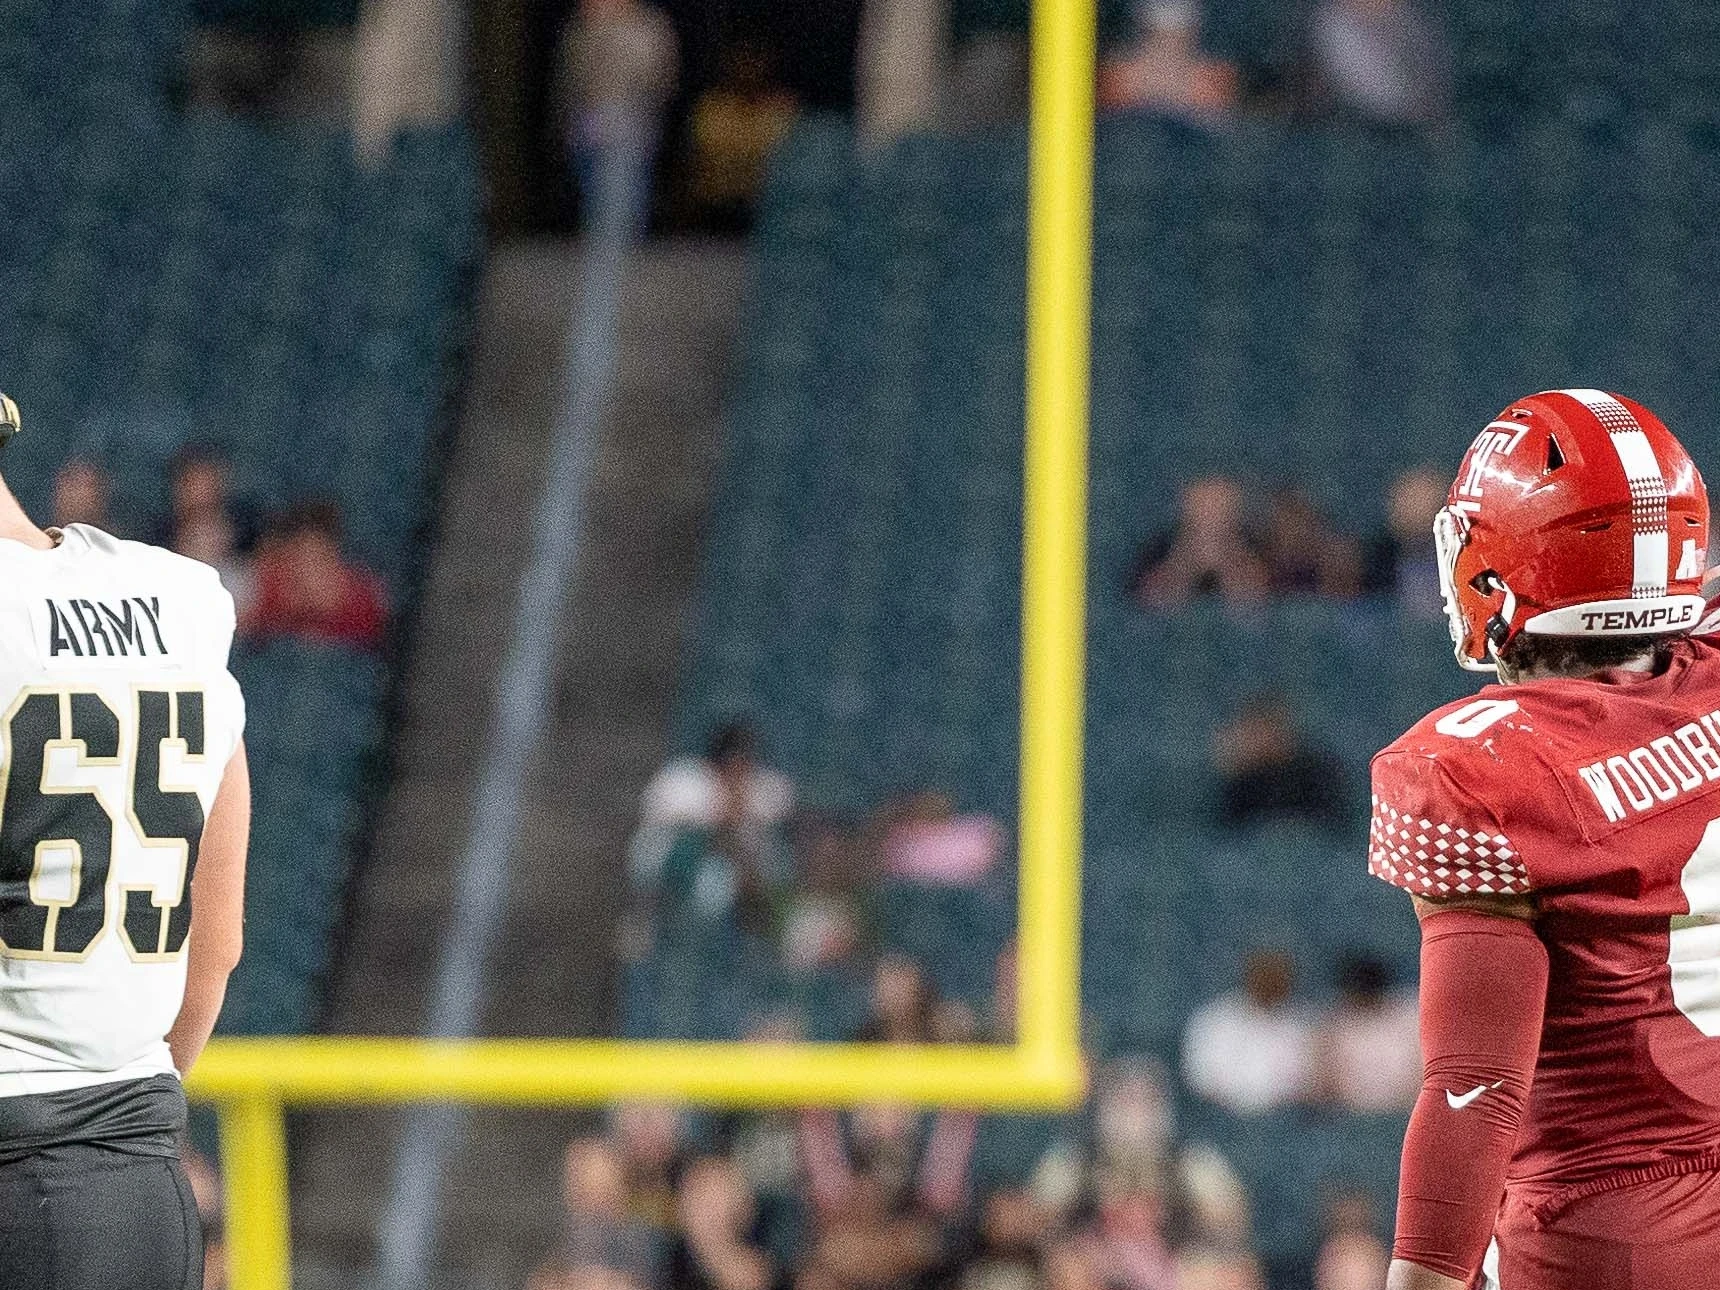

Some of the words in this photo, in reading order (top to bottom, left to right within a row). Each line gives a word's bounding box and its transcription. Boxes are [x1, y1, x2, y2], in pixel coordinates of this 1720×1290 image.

[46, 597, 168, 657] ARMY
[1580, 605, 1693, 631] TEMPLE
[1434, 699, 1520, 738] 0
[0, 683, 205, 962] 65
